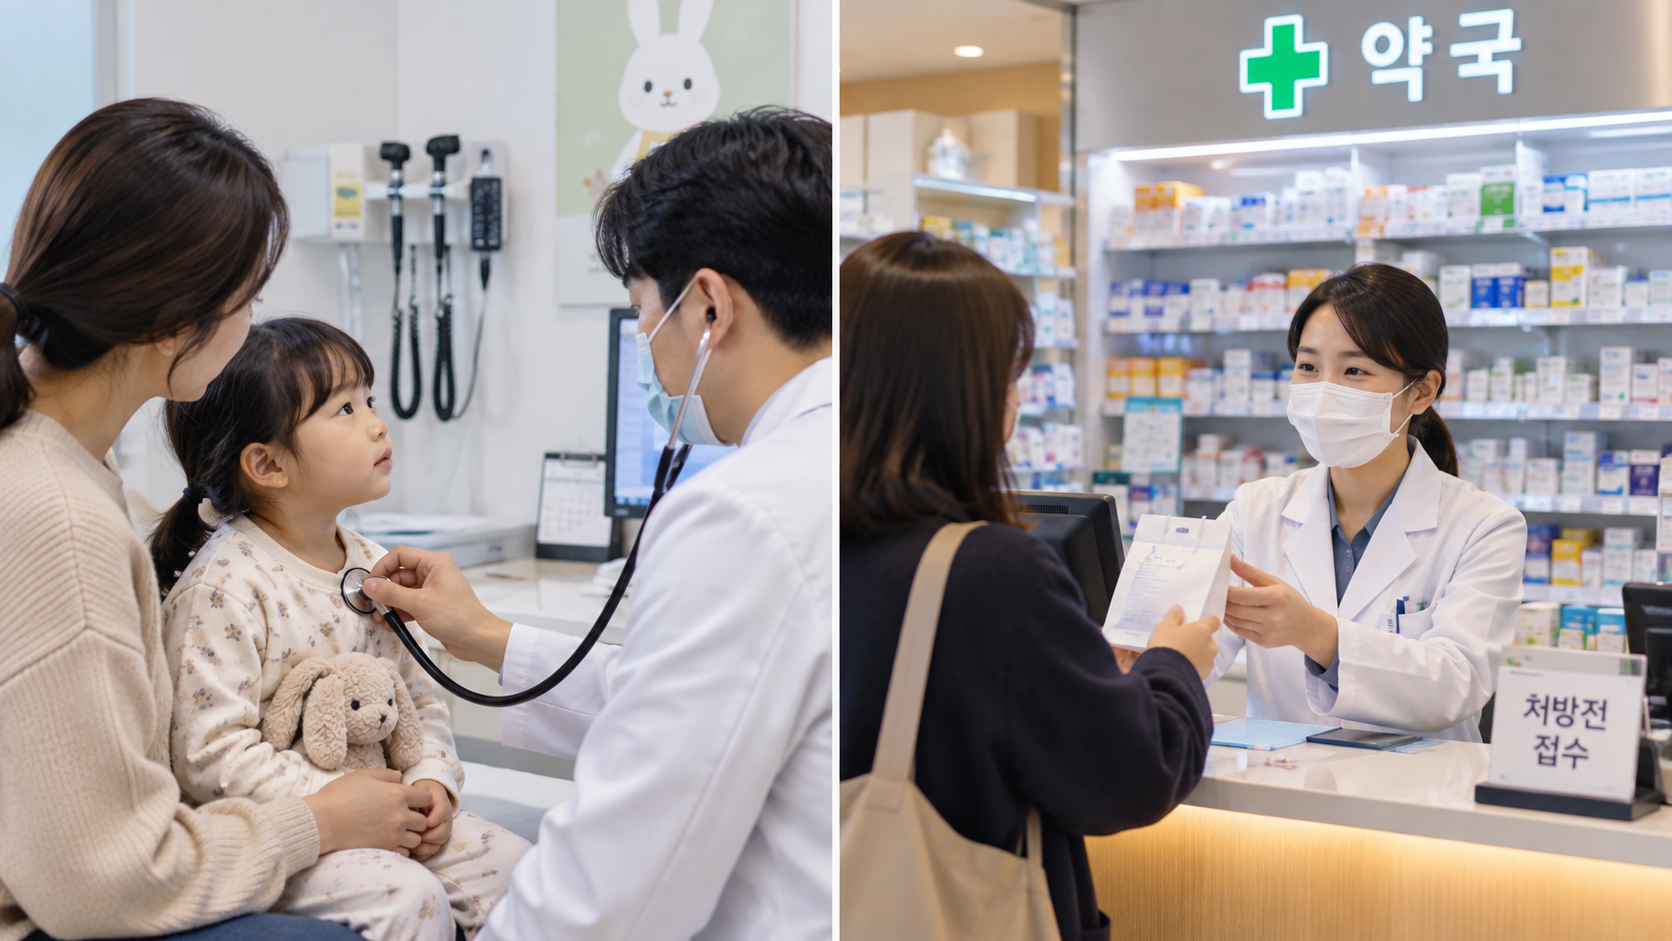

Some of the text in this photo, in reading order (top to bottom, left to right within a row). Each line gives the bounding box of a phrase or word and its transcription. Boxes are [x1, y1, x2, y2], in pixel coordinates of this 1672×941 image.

[1362, 9, 1520, 101] 약국
[1523, 693, 1608, 731] 처방전
[1533, 734, 1589, 770] 접수
